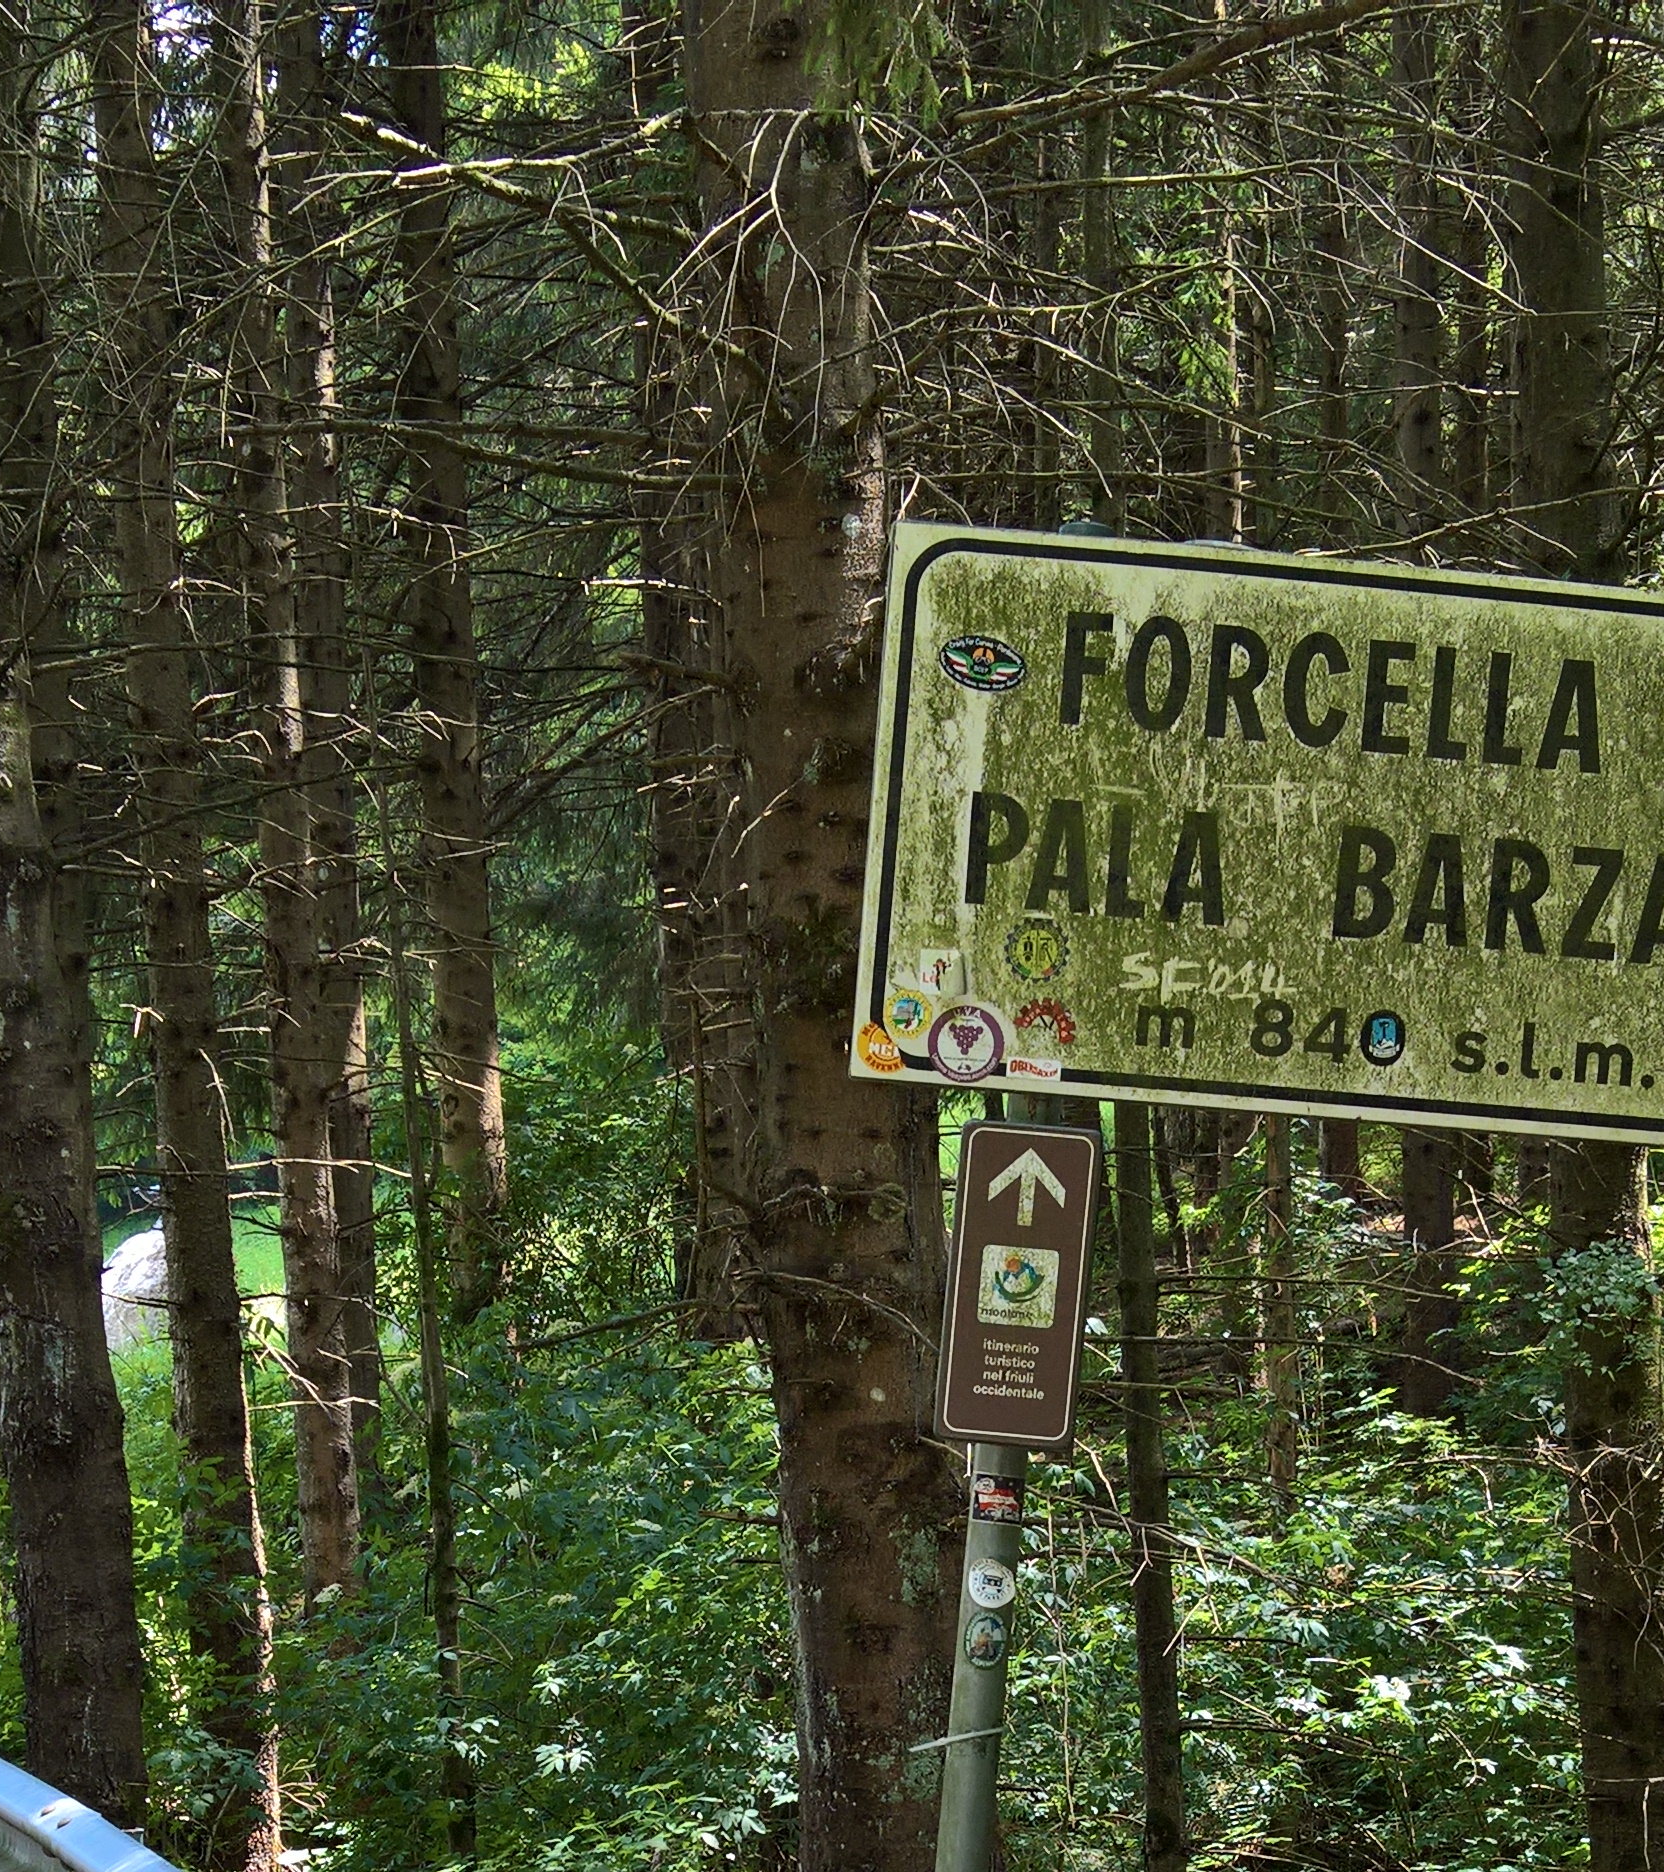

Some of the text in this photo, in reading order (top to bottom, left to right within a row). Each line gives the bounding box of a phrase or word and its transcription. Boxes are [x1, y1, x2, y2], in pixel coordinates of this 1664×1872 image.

[1059, 611, 1602, 776] FORCELLA
[964, 790, 1226, 929] PALA
[1136, 1003, 1196, 1049] m
[1250, 998, 1406, 1067] 840
[1450, 1022, 1655, 1089] s.l.m.
[983, 1338, 1040, 1354] itinerario
[984, 1354, 1036, 1369] turistico
[983, 1369, 1035, 1384] nel friuli
[973, 1384, 1045, 1400] occidentale
